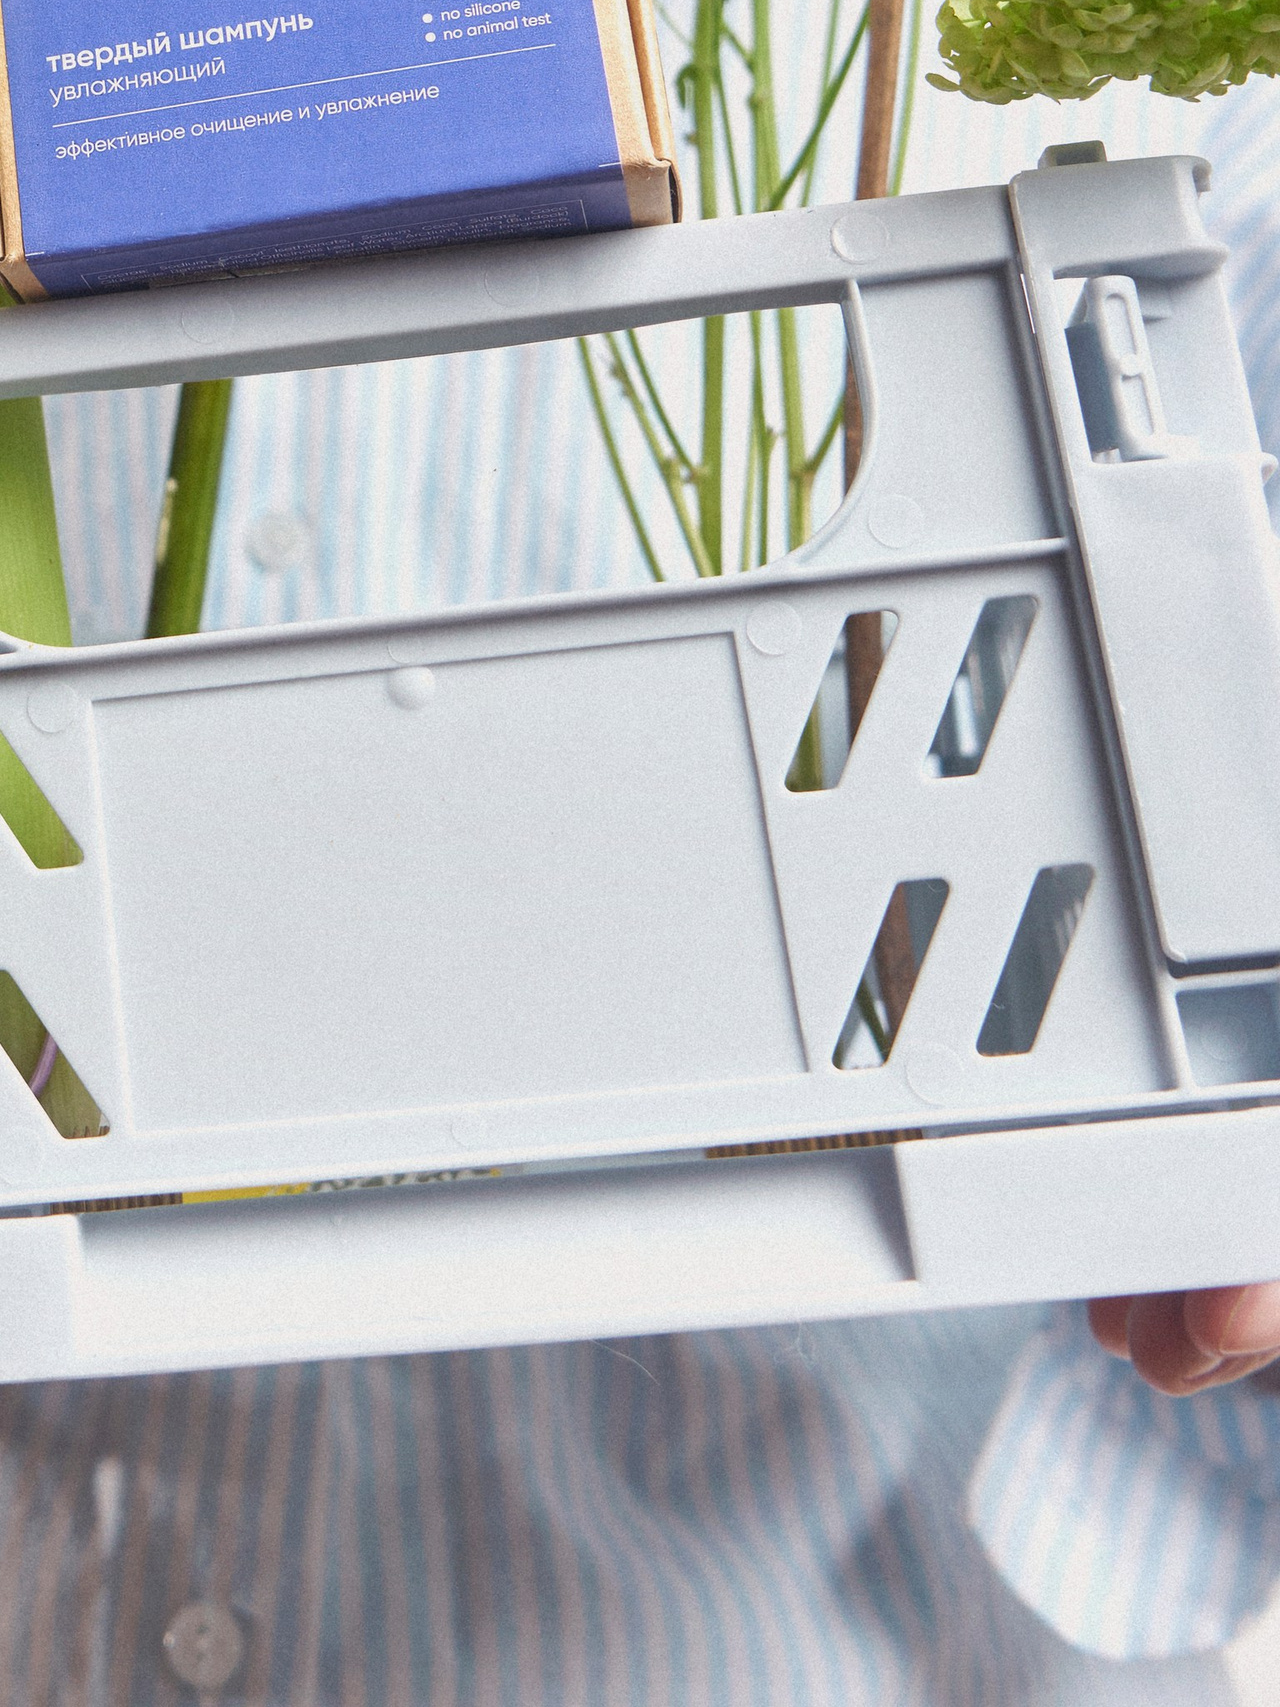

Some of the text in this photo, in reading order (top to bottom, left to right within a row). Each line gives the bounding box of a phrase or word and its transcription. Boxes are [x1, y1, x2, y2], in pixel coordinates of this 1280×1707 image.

[440, 0, 521, 21] no silicone
[442, 12, 552, 40] no animal test
[45, 12, 314, 72] твердый шампунь
[49, 56, 227, 107] увлажняющий
[55, 85, 440, 160] эффективное очищение и увлажнение
[421, 221, 459, 231] Coco
[530, 205, 568, 215] Coco
